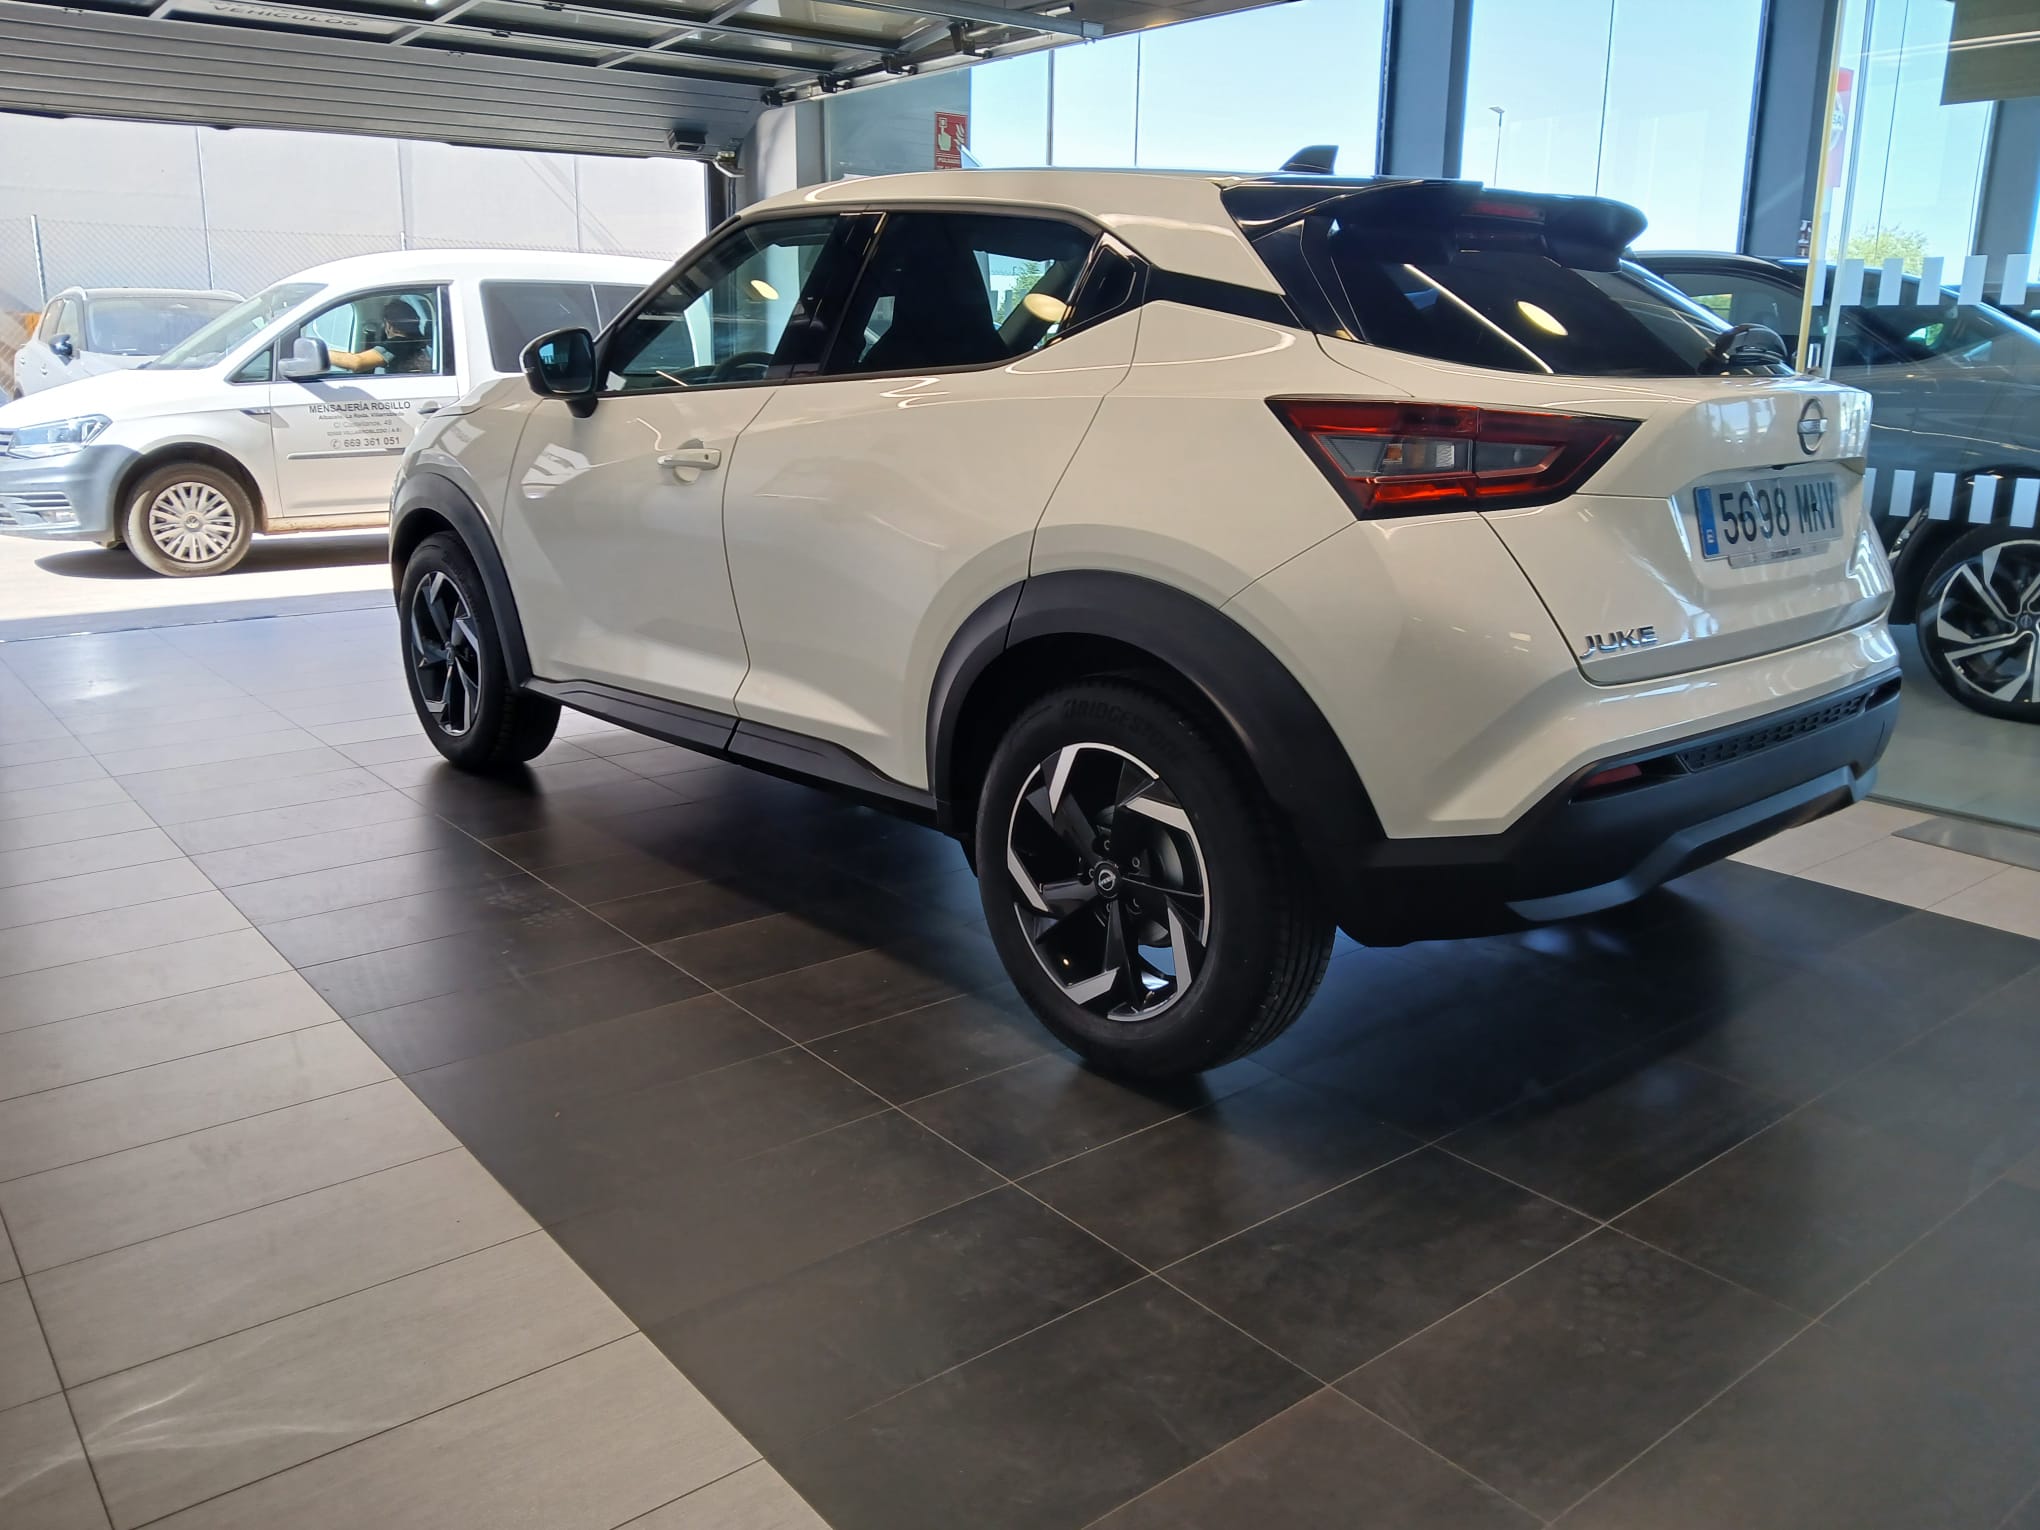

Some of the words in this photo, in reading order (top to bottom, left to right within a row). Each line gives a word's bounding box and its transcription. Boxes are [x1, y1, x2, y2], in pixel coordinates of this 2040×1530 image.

[309, 401, 371, 414] MENSAJERÍA
[371, 401, 411, 411] ROSILLO
[344, 438, 361, 448] 669
[364, 437, 381, 447] 361
[383, 436, 400, 446] 051
[1719, 487, 1790, 545] 5698
[1794, 481, 1837, 534] MNV
[1579, 625, 1658, 660] JUKE
